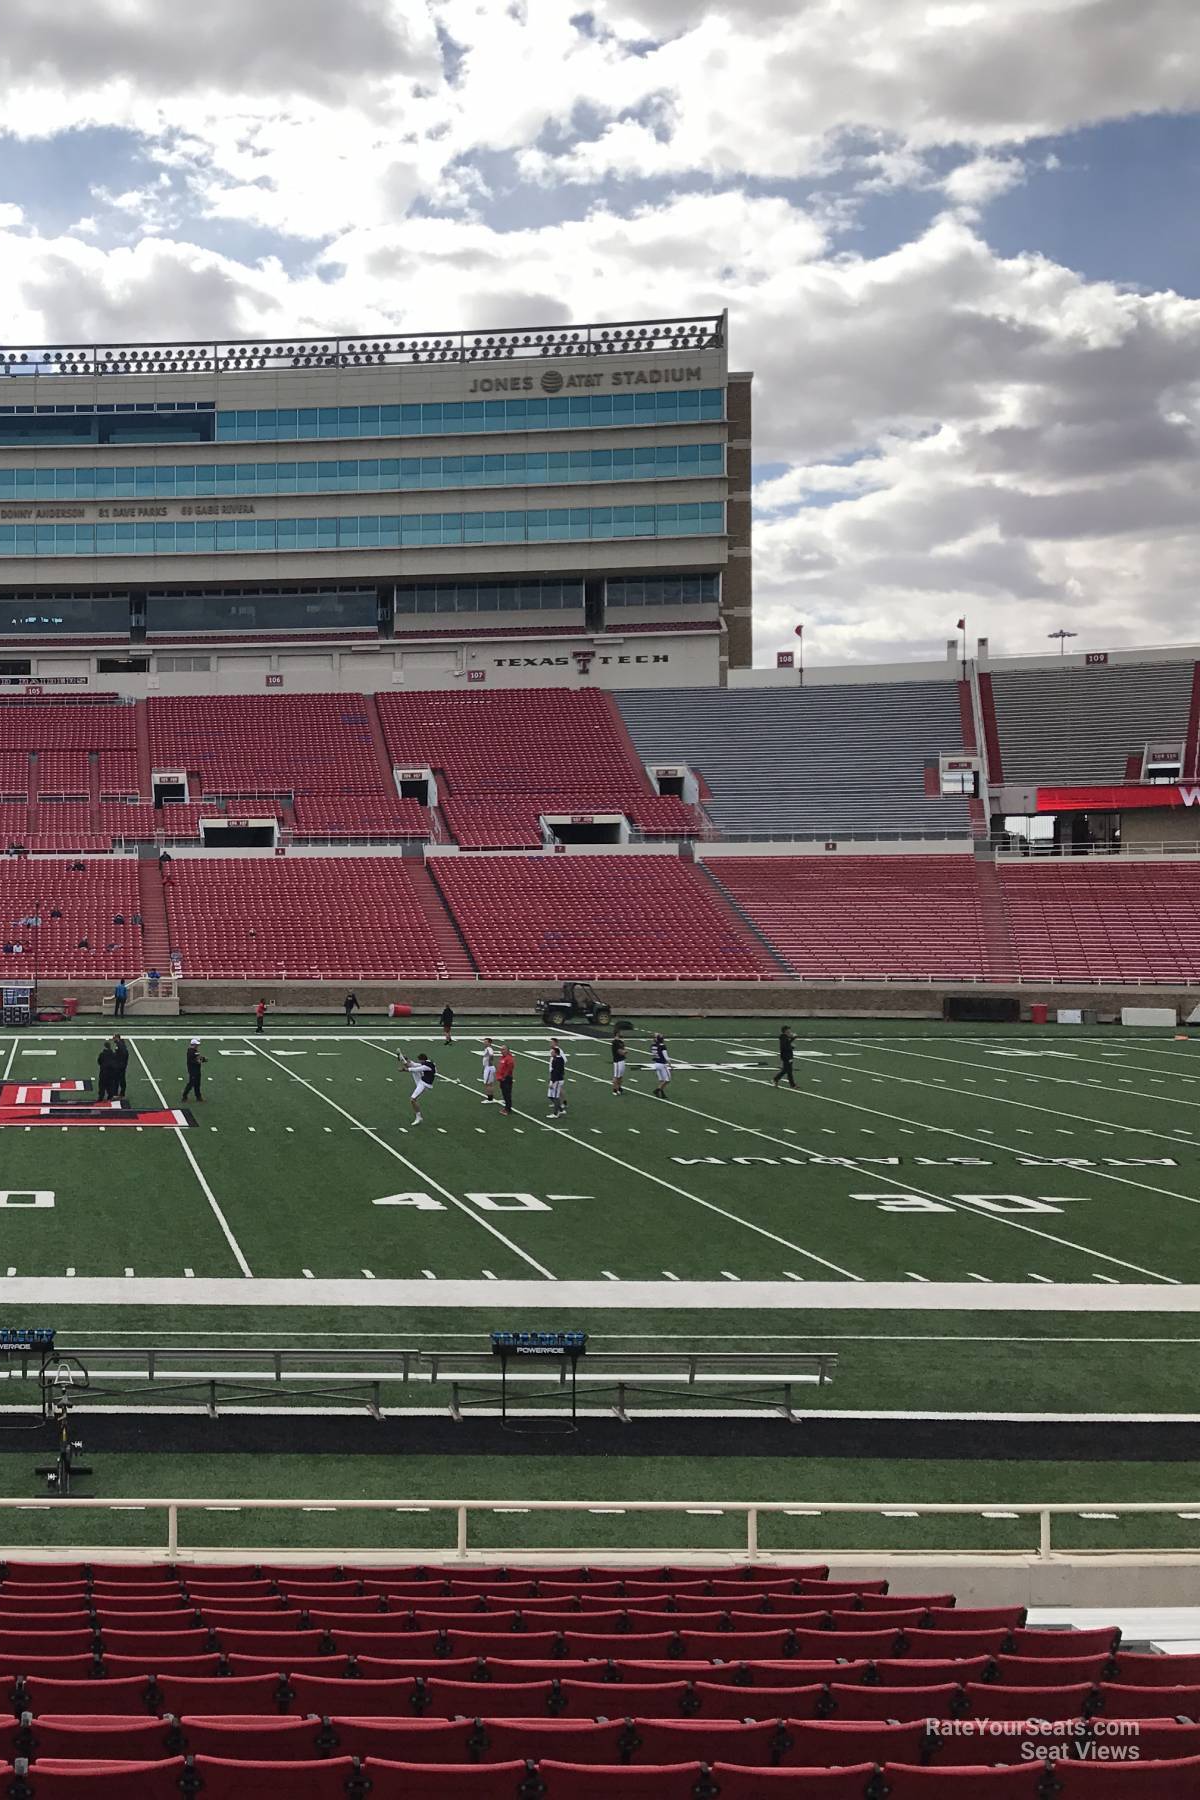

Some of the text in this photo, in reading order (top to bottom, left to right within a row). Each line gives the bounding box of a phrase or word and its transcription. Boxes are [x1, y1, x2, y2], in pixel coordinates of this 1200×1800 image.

[469, 366, 702, 393] JONES AT&T STADIUM
[1, 509, 33, 519] DONNY
[35, 508, 85, 519] ANDERSON
[112, 507, 136, 517] DAVE
[138, 506, 168, 517] PARKS
[494, 657, 569, 667] TEXAS
[599, 655, 669, 665] TECH
[1088, 654, 1104, 662] 109
[516, 1346, 565, 1354] POWERADE
